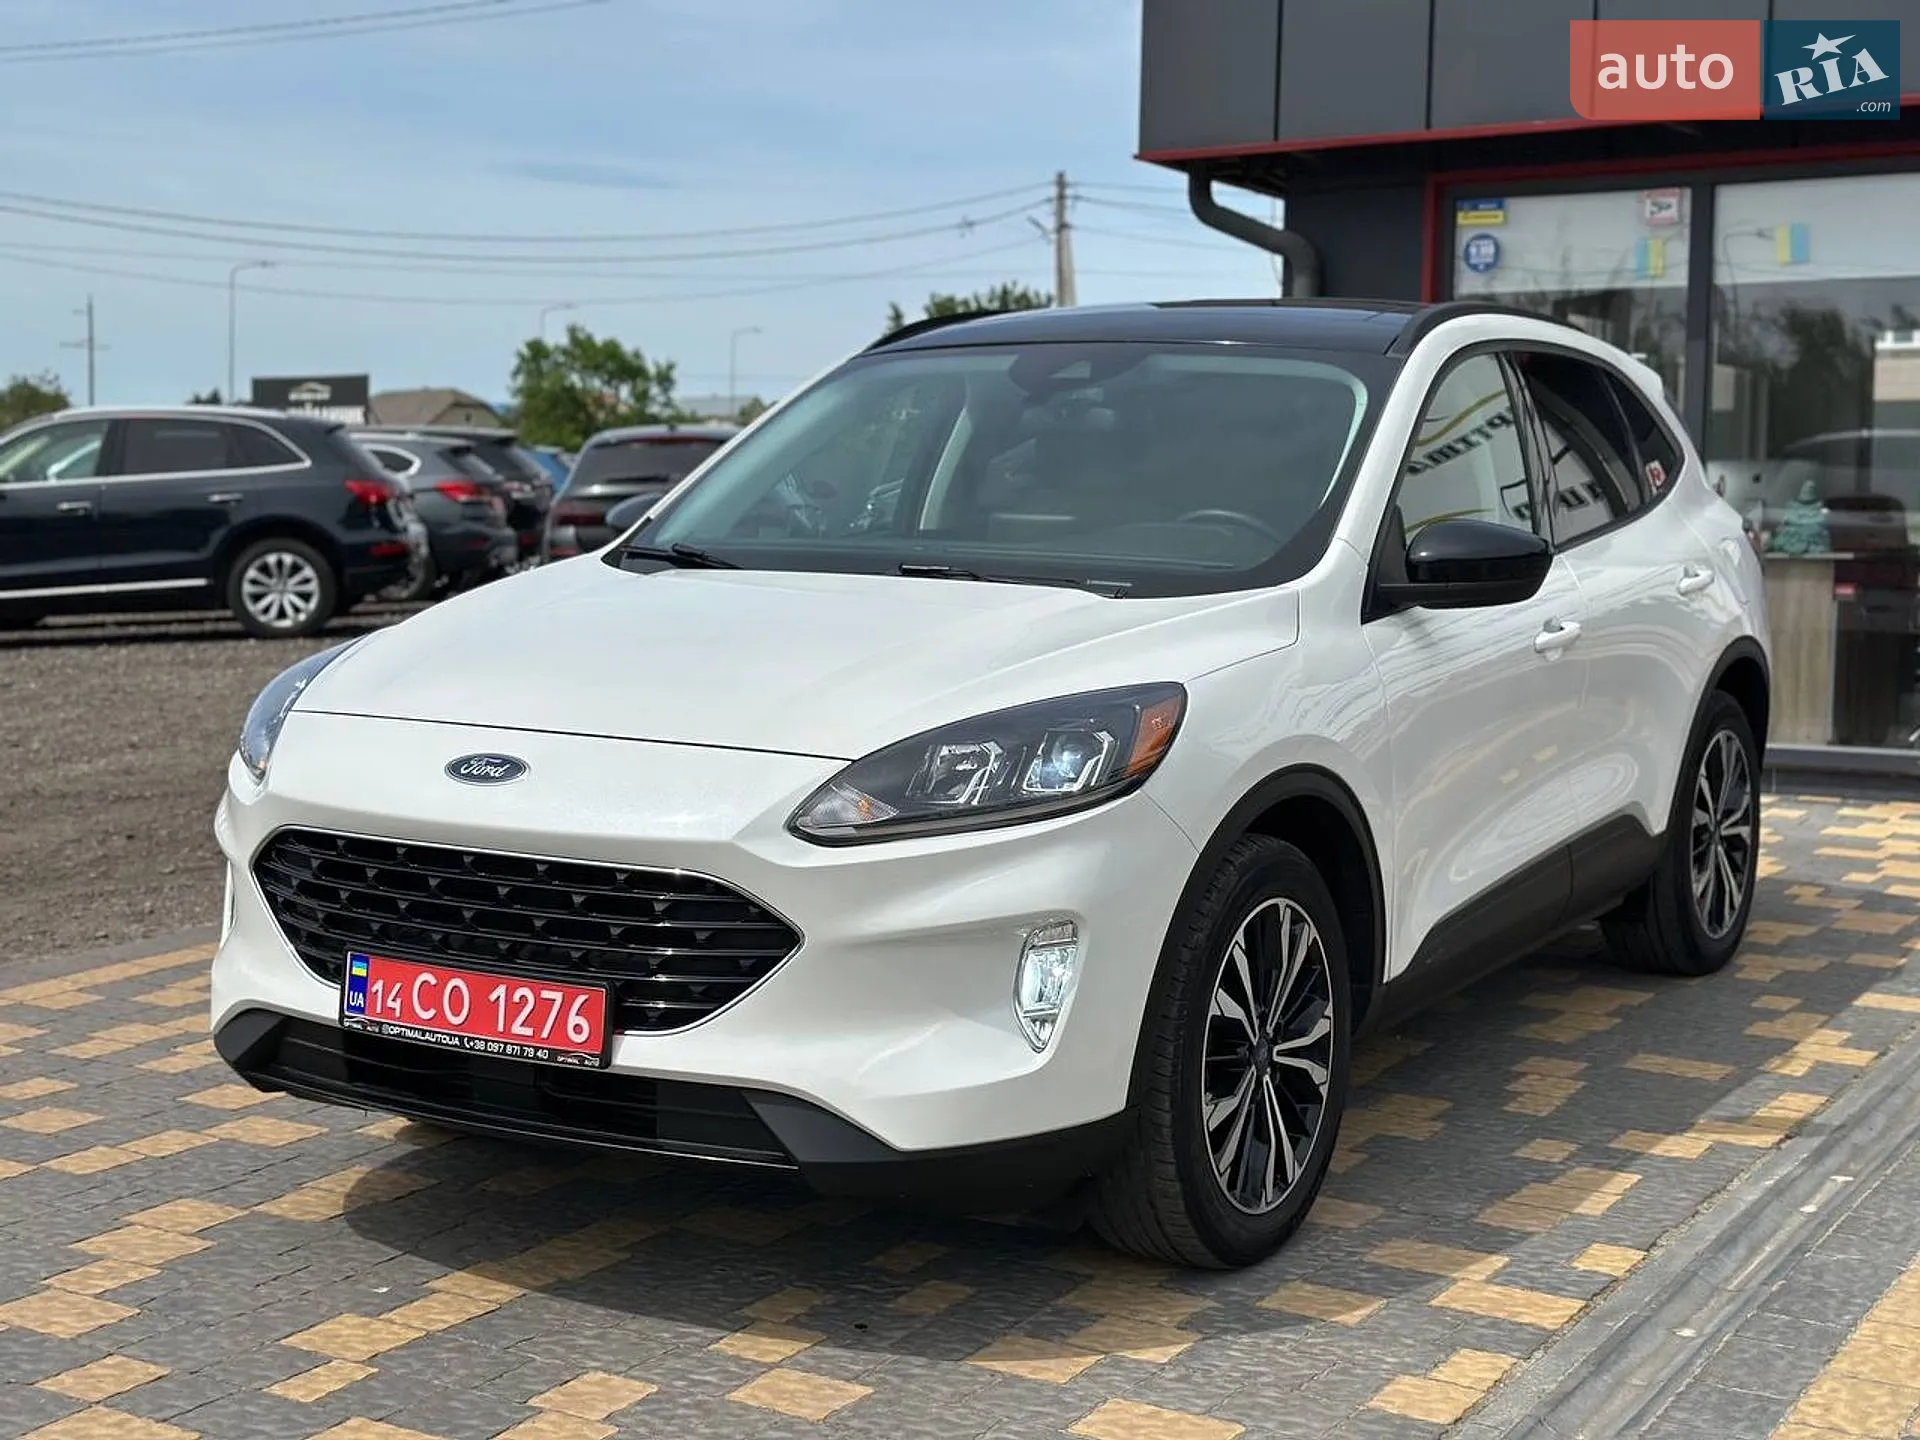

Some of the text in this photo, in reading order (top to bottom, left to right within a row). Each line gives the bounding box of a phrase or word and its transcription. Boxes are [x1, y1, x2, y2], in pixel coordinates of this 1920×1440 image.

[460, 757, 511, 777] Ford
[350, 991, 364, 1008] UA
[371, 971, 590, 1044] 14 CO 1276
